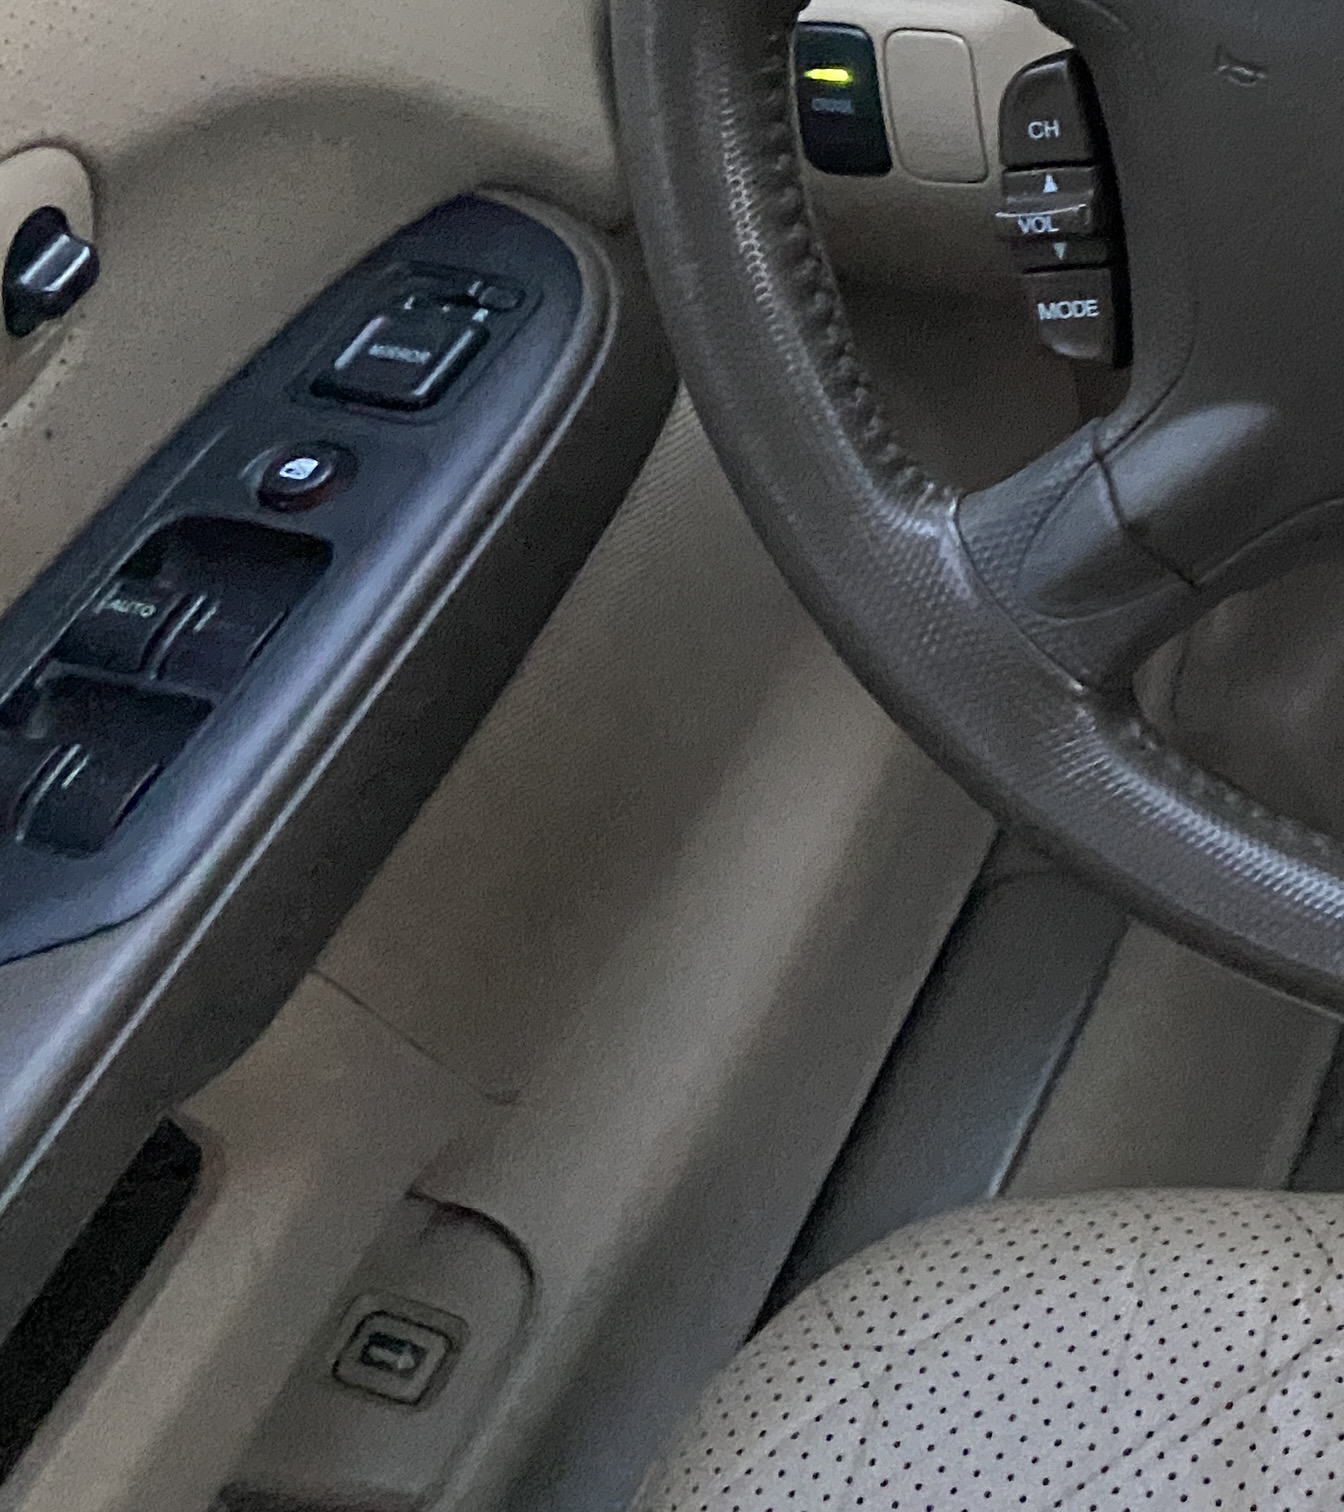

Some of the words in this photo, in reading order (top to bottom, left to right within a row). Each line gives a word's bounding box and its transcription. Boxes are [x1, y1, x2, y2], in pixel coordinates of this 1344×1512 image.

[1027, 119, 1061, 140] CH
[1018, 215, 1060, 234] VOL
[1037, 299, 1100, 322] MODE
